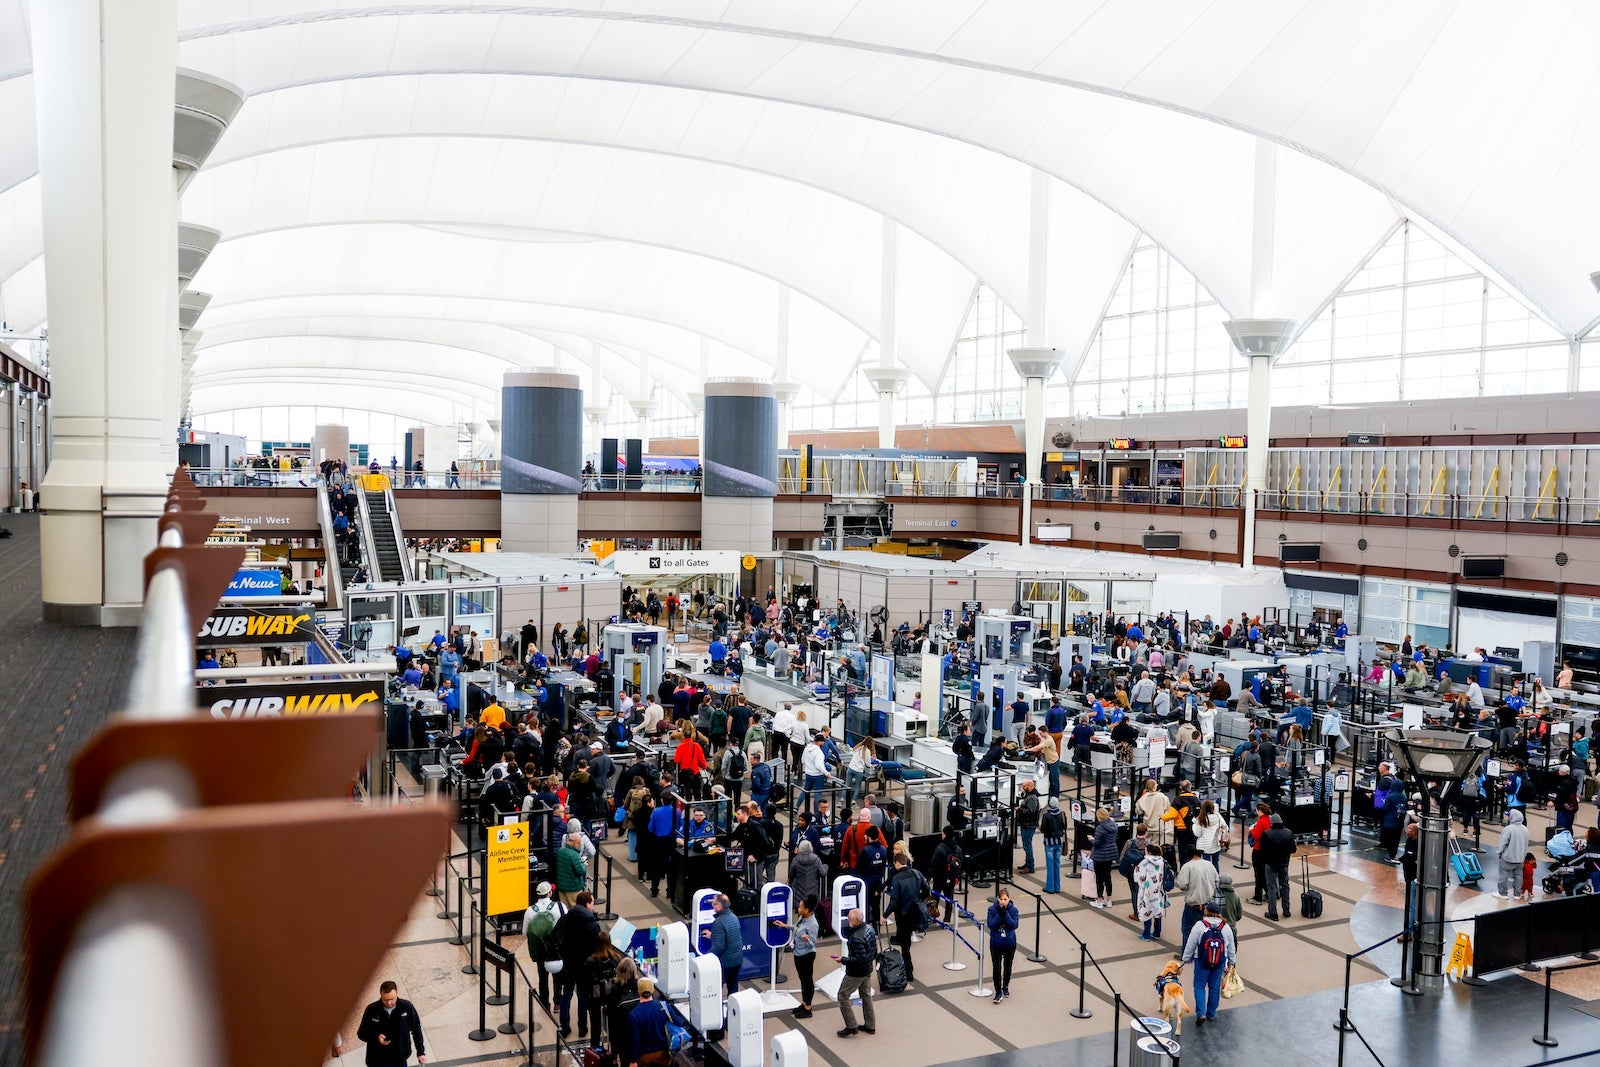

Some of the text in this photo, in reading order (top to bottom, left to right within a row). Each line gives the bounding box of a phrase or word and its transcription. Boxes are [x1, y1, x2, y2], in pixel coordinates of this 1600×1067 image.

[266, 516, 290, 525] West
[663, 558, 709, 567] to all Gates
[239, 577, 279, 589] News
[197, 613, 311, 638] SUBWAY
[210, 689, 380, 721] SUBWAY
[489, 849, 509, 857] Airline
[497, 854, 526, 863] Members
